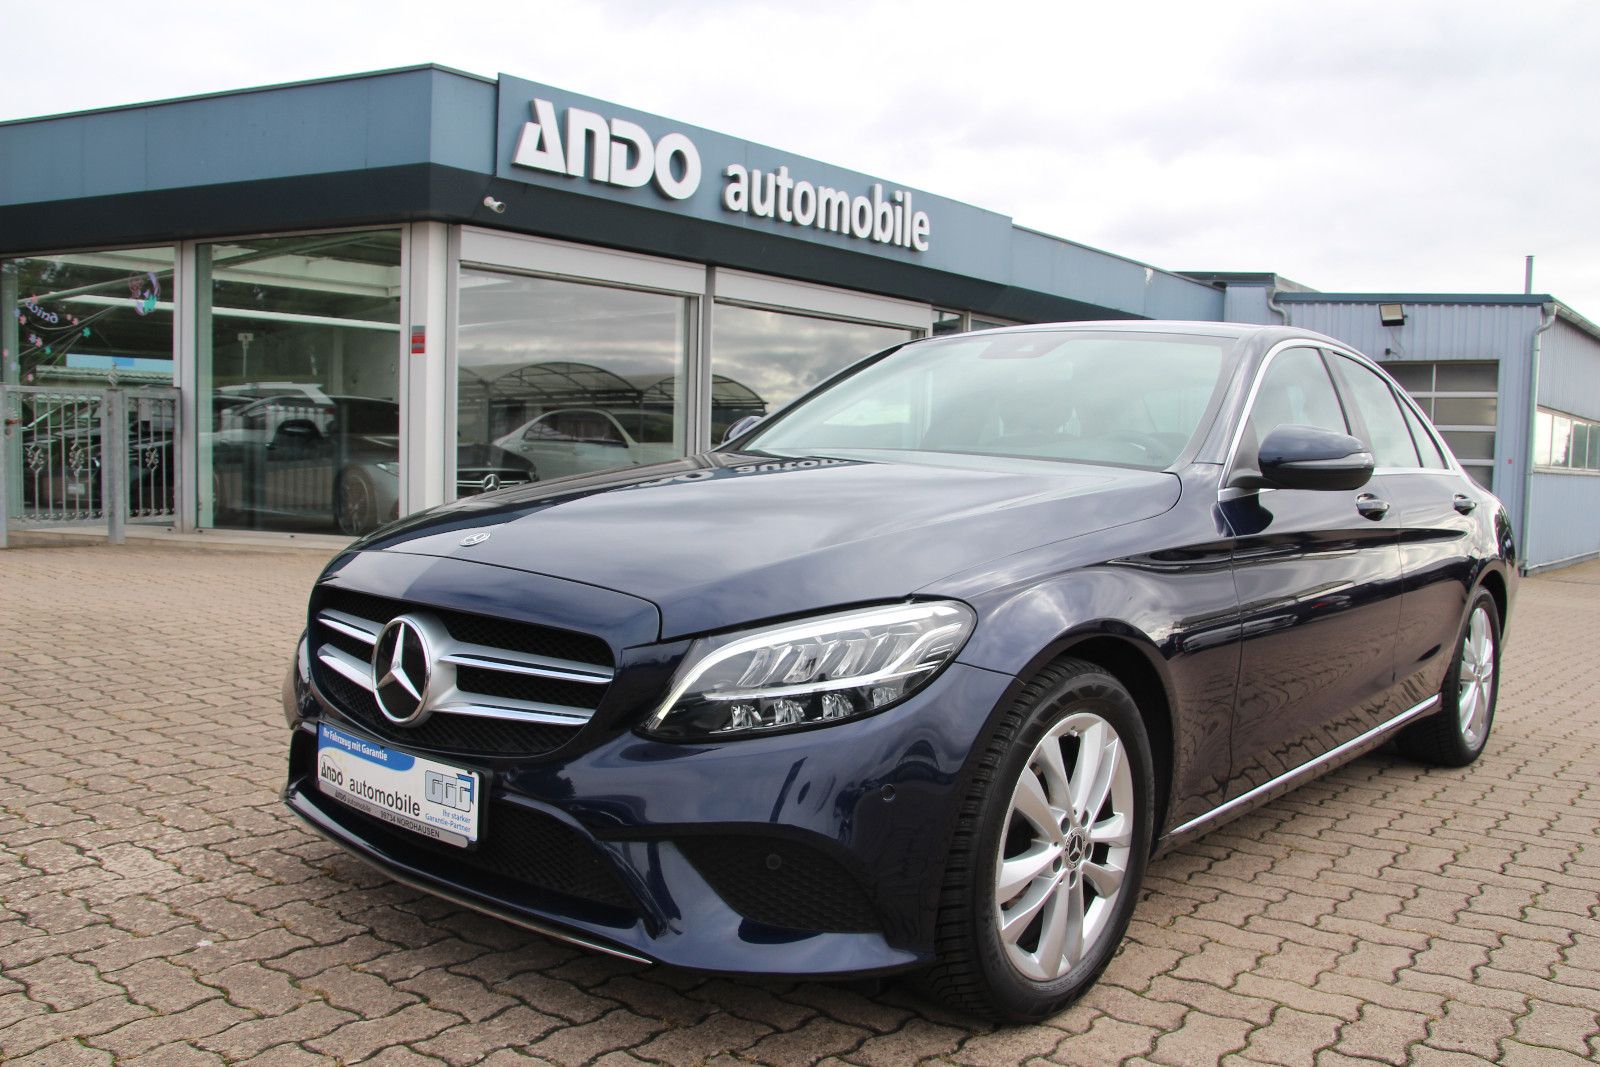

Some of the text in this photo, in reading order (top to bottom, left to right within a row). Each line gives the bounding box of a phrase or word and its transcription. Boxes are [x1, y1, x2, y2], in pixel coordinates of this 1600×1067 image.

[722, 163, 930, 252] automobile
[329, 730, 351, 749] Fahrzeug
[352, 741, 361, 751] mit
[362, 744, 388, 761] Garantie
[349, 778, 420, 817] automobile
[380, 811, 396, 823] 99734
[396, 815, 440, 838] NORDHAUSEN
[425, 813, 471, 833] Garantie-Partner
[442, 810, 471, 823] Ihr starker
